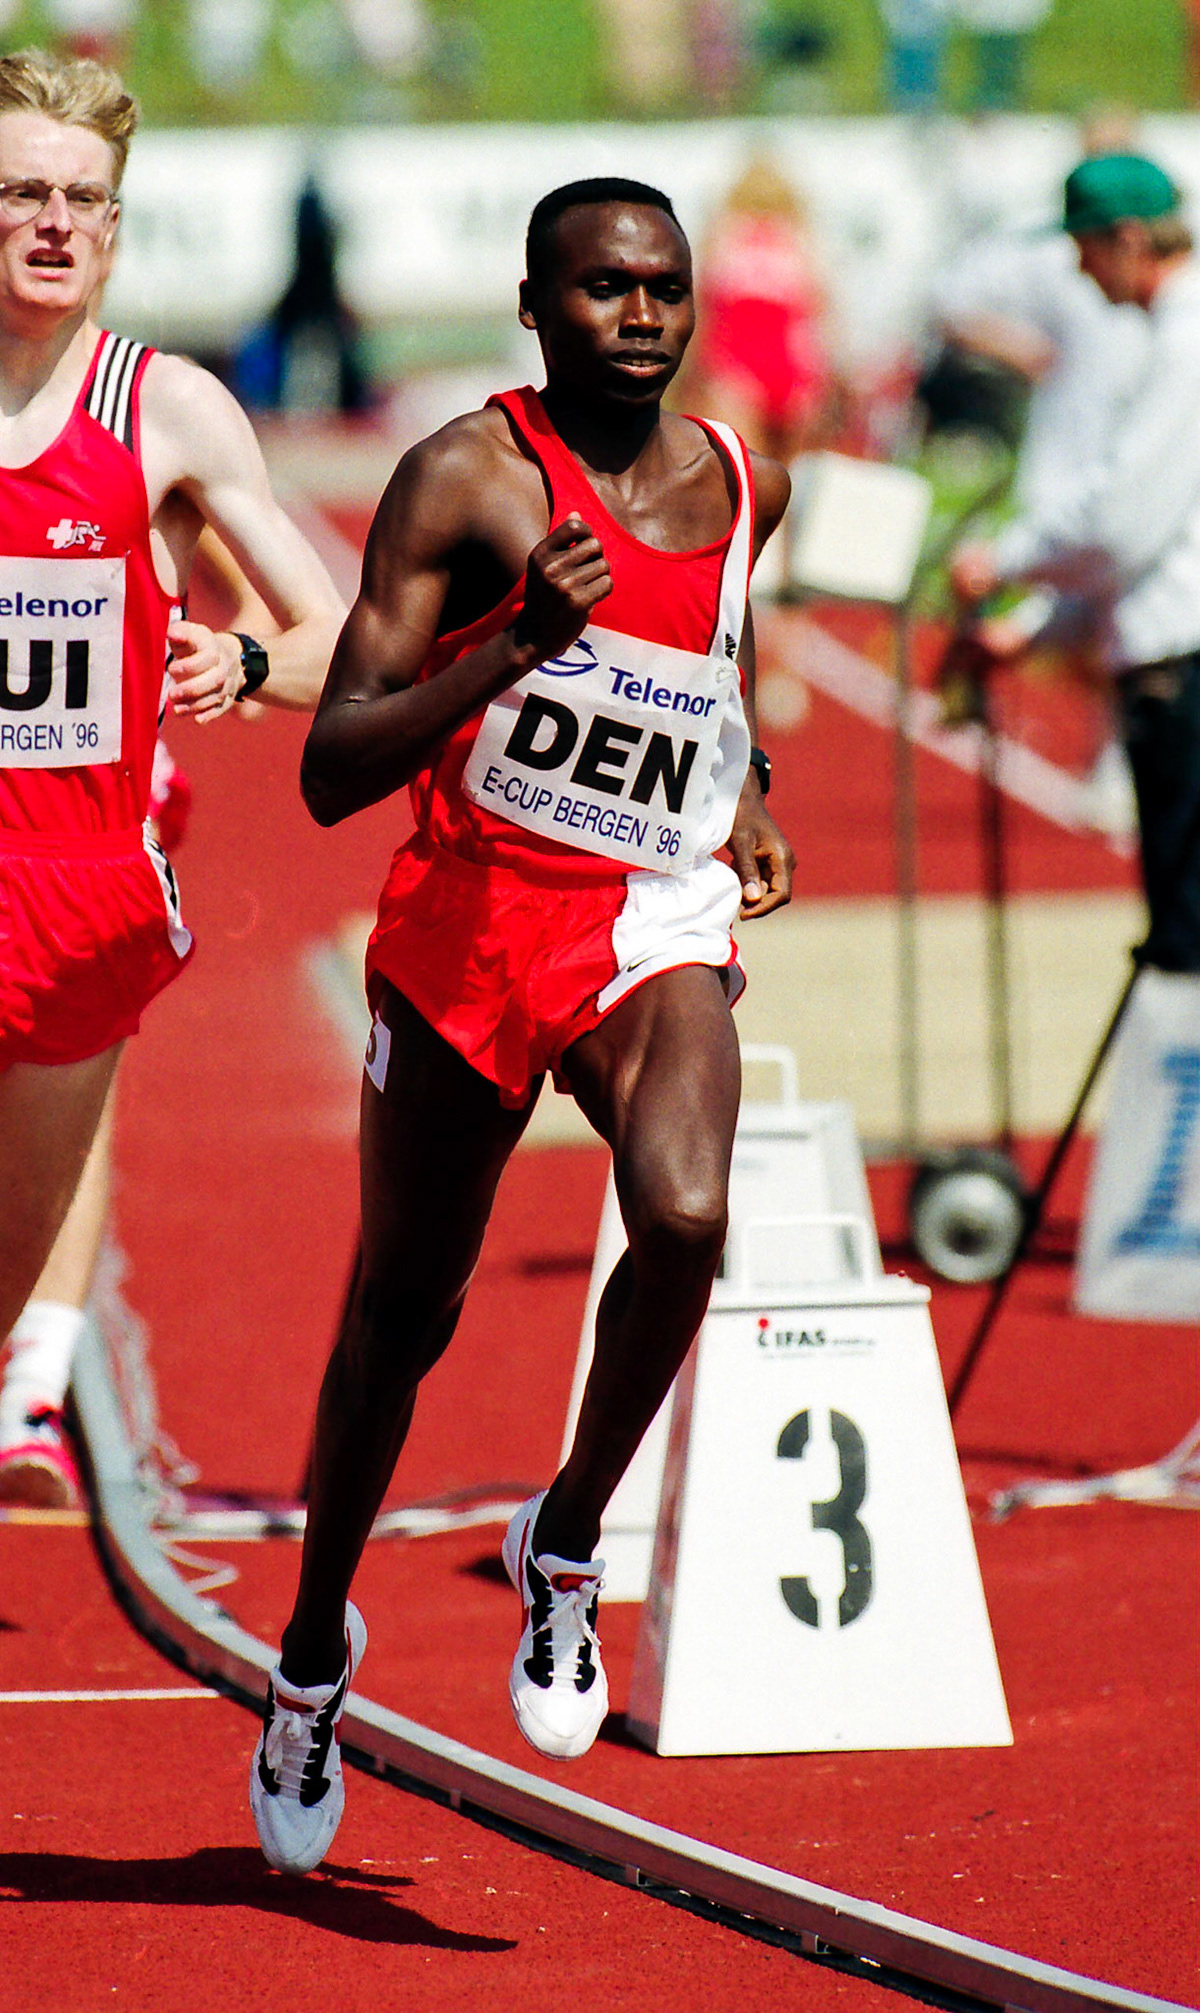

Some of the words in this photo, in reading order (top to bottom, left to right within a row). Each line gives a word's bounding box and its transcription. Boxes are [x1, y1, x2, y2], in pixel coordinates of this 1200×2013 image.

[0, 592, 107, 617] elenor
[0, 639, 89, 711] UI
[609, 667, 716, 717] Telenor
[1, 724, 63, 750] RGEN
[504, 692, 699, 814] DEN
[482, 766, 552, 814] E-CUP
[553, 796, 648, 847] BERGEN
[777, 1408, 873, 1631] 3
